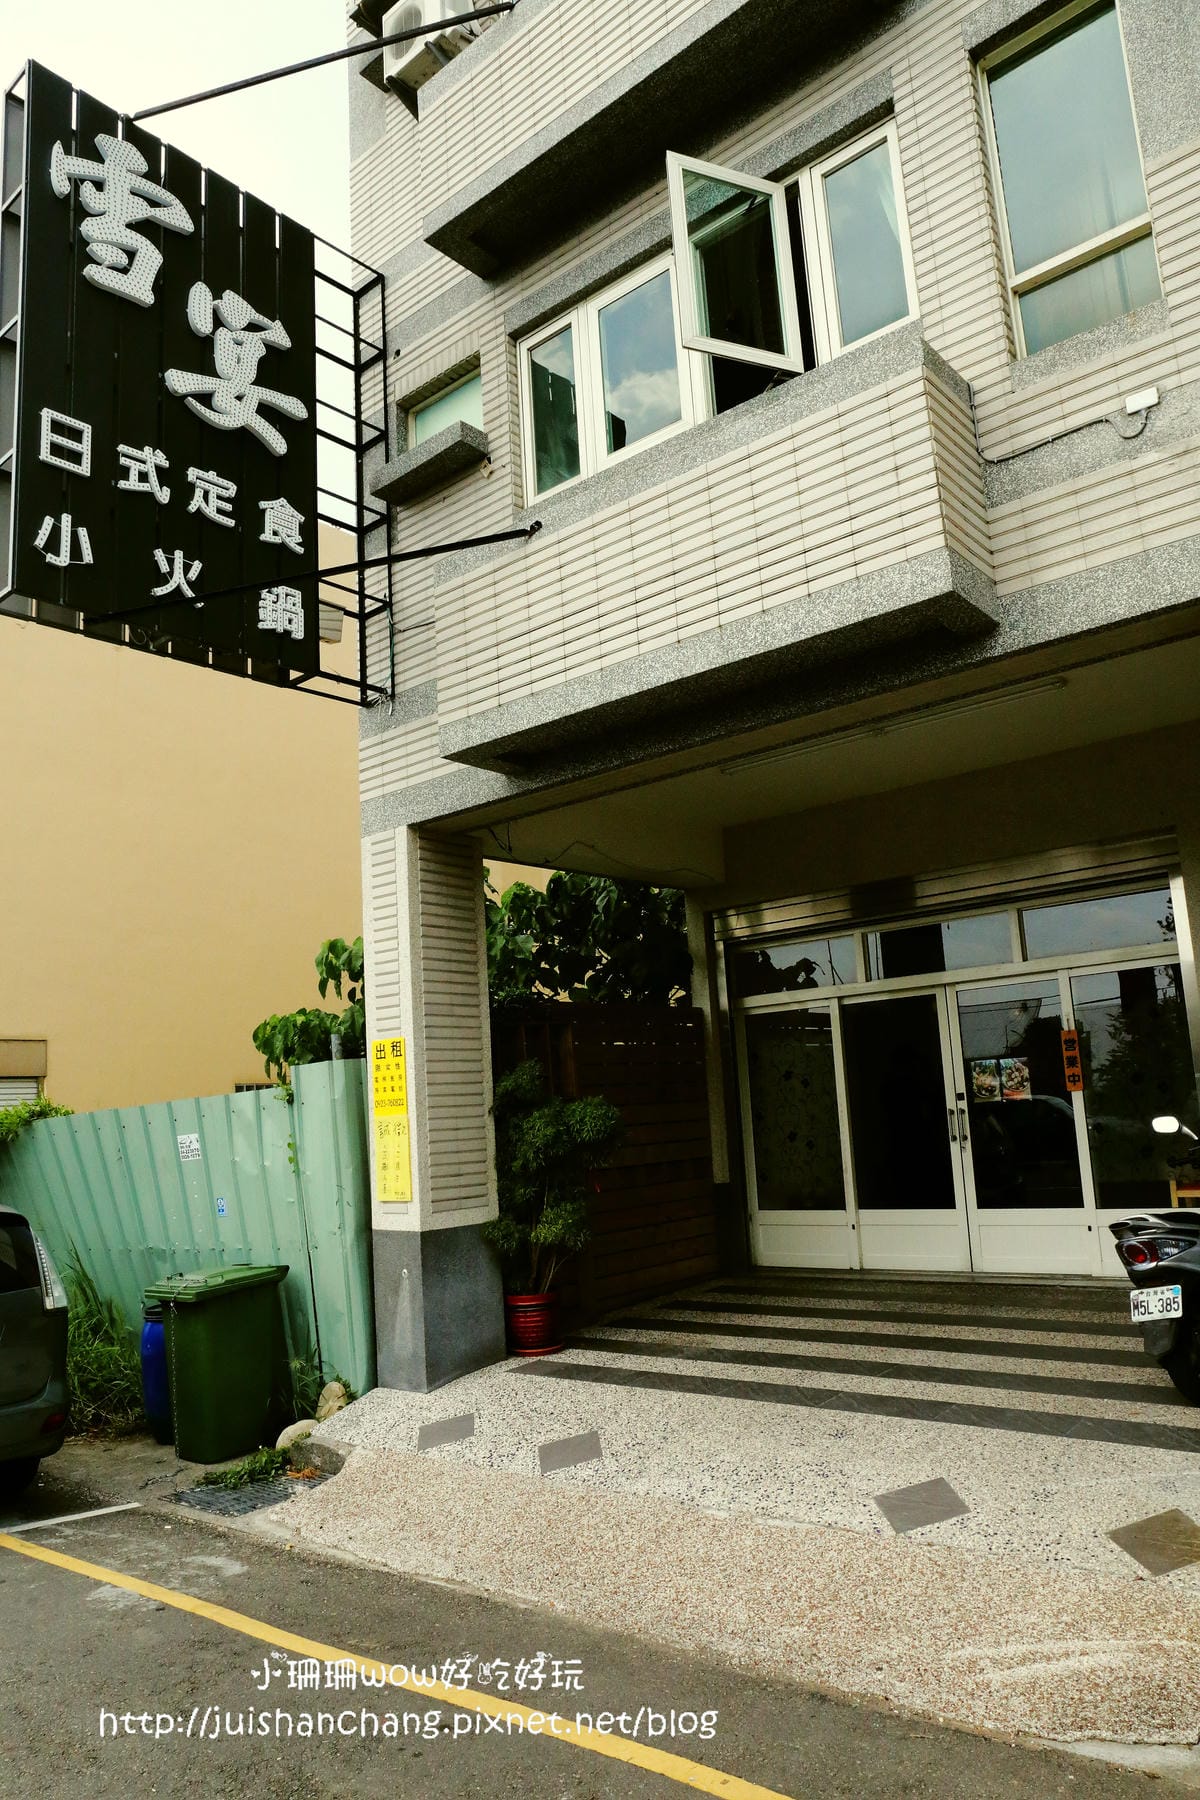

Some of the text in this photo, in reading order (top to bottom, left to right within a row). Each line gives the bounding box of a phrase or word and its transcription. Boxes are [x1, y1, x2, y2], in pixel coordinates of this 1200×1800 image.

[39, 407, 305, 555] 日式定食
[33, 512, 305, 641] 小火鍋
[375, 1040, 403, 1060] 出租
